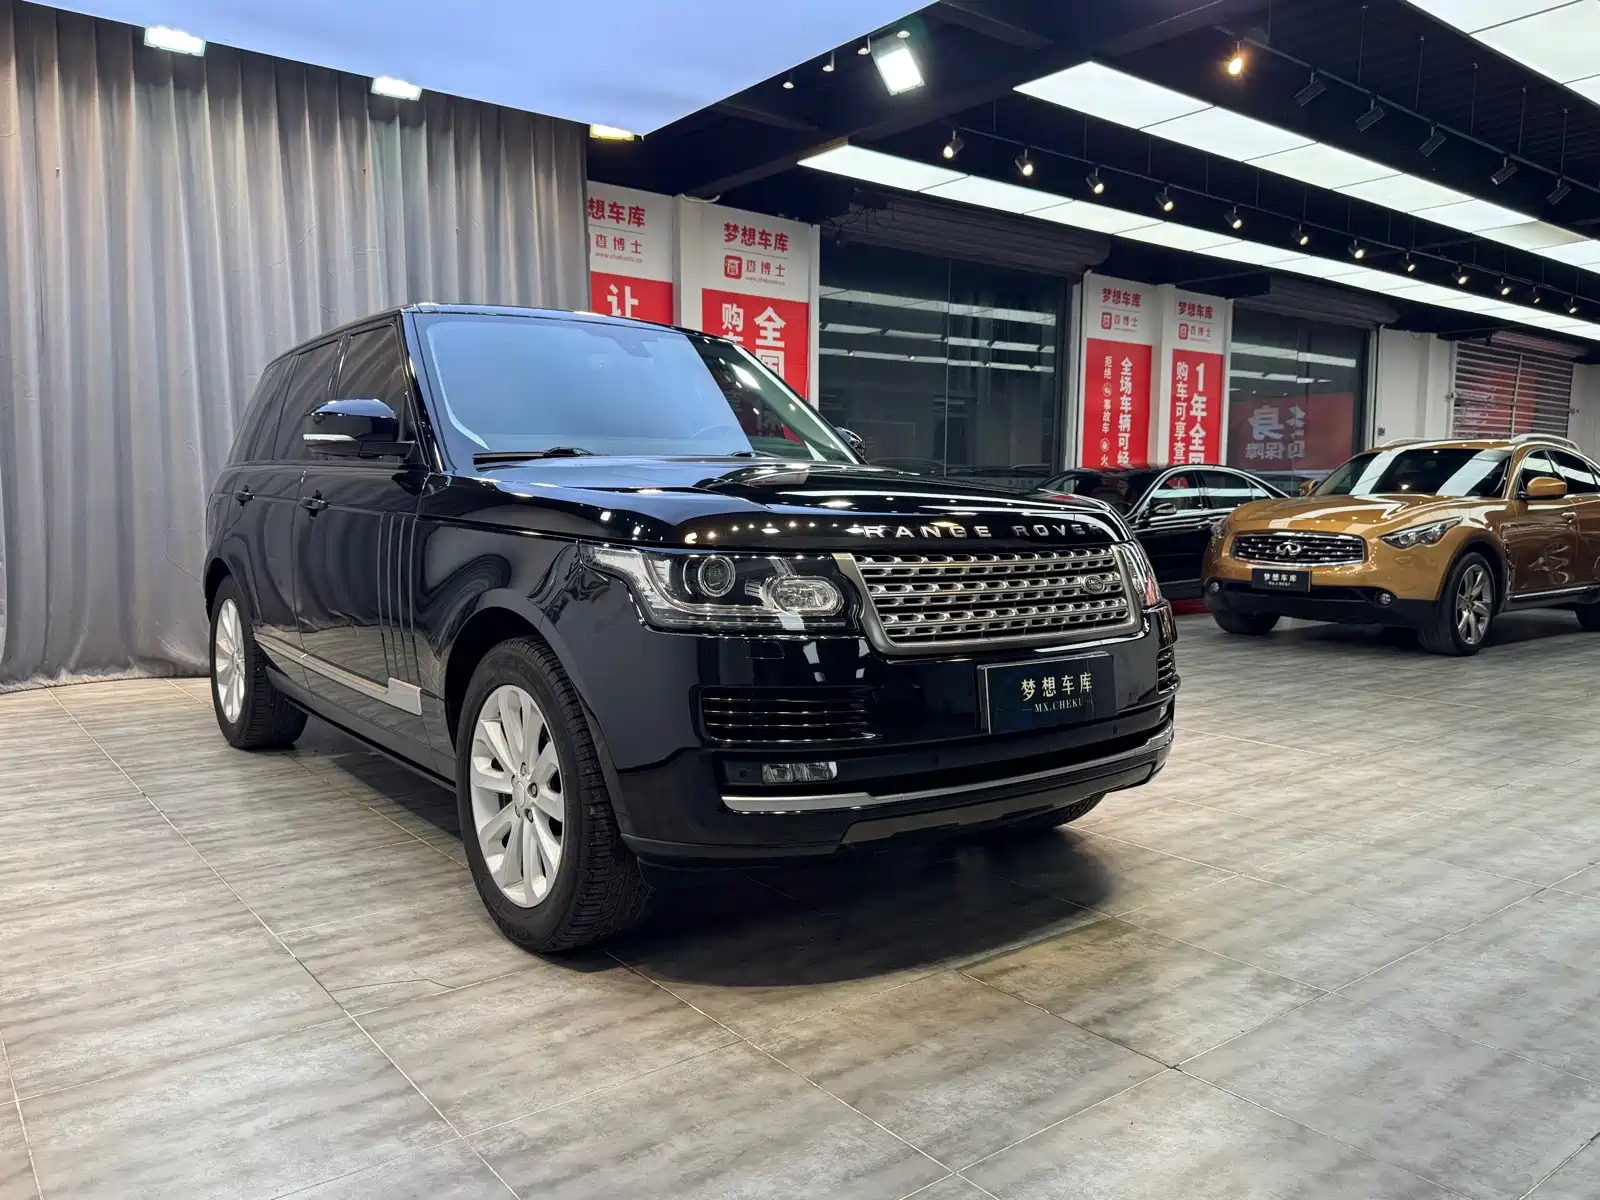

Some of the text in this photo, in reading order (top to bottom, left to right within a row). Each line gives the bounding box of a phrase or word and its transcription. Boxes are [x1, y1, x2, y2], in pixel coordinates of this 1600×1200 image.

[724, 223, 788, 252] 梦想车库
[1102, 287, 1141, 308] 梦想车库
[1178, 301, 1213, 320] 梦想车库
[863, 525, 992, 539] RANGE
[1020, 672, 1093, 702] 梦想车库
[1034, 697, 1084, 713] MX.CHEKU
